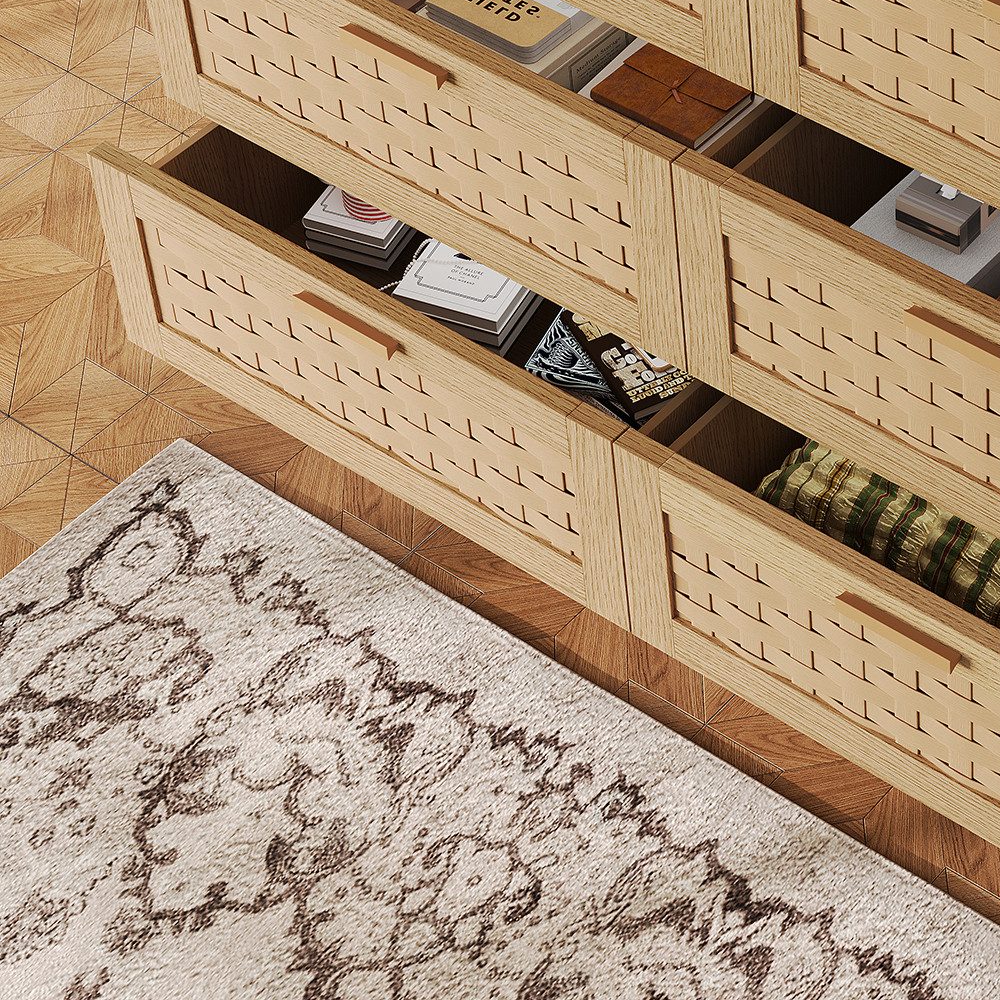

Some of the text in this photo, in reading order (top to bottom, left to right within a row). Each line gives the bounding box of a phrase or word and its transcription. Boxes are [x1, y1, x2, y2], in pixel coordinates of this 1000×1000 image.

[576, 53, 600, 74] Medium
[600, 36, 622, 55] Storage
[663, 376, 685, 391] AND
